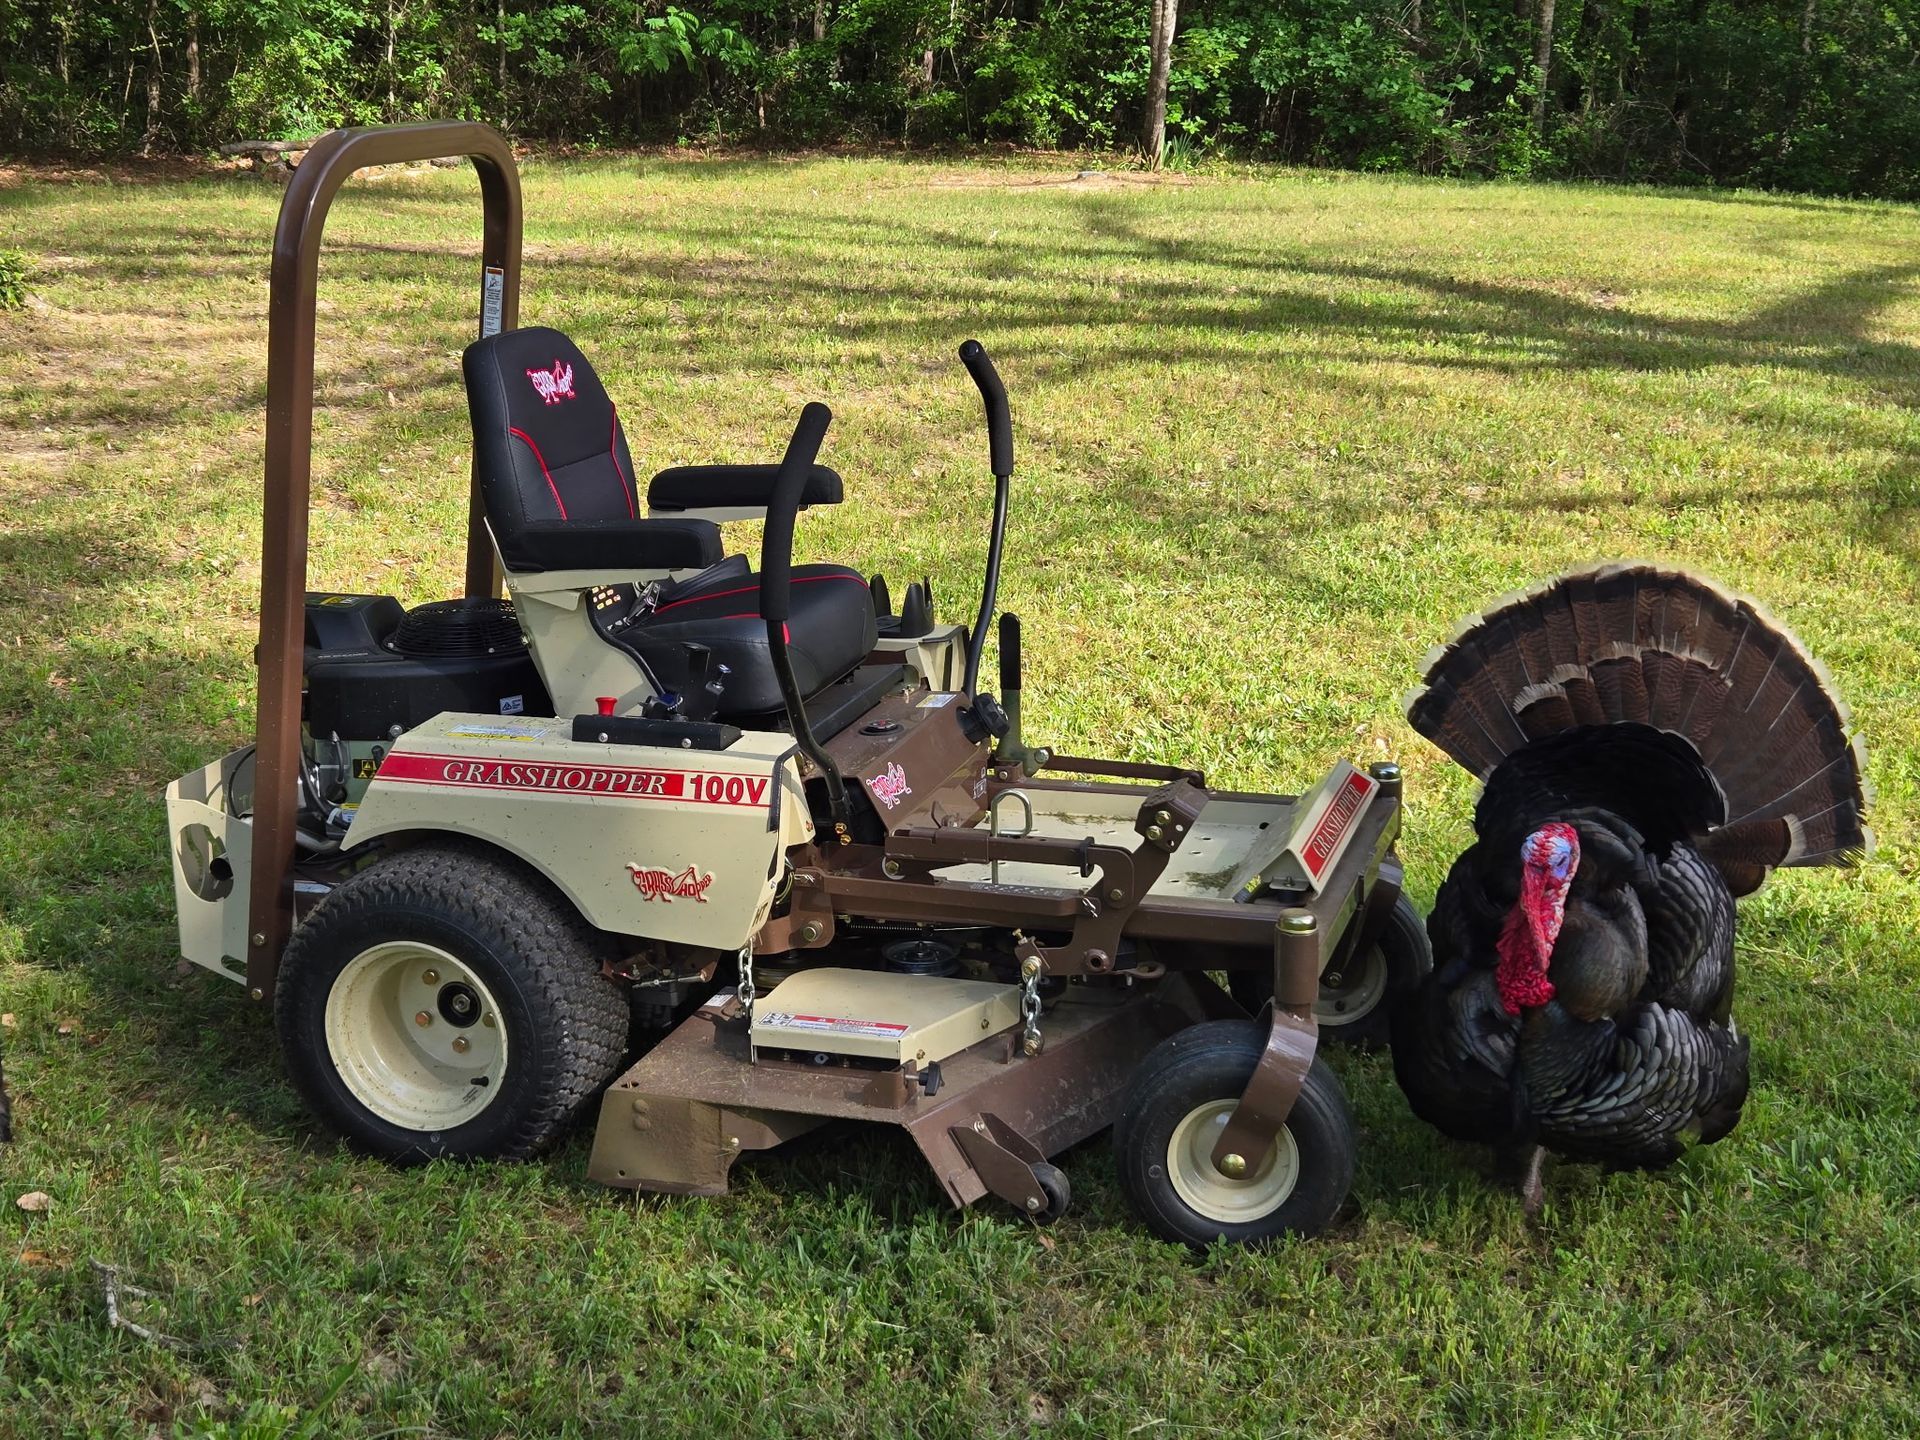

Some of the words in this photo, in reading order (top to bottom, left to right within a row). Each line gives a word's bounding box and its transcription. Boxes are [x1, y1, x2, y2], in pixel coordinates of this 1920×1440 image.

[443, 762, 666, 794] GRASSHOPPER
[689, 775, 768, 804] 100V
[1312, 784, 1361, 859] GRASSHOPPER
